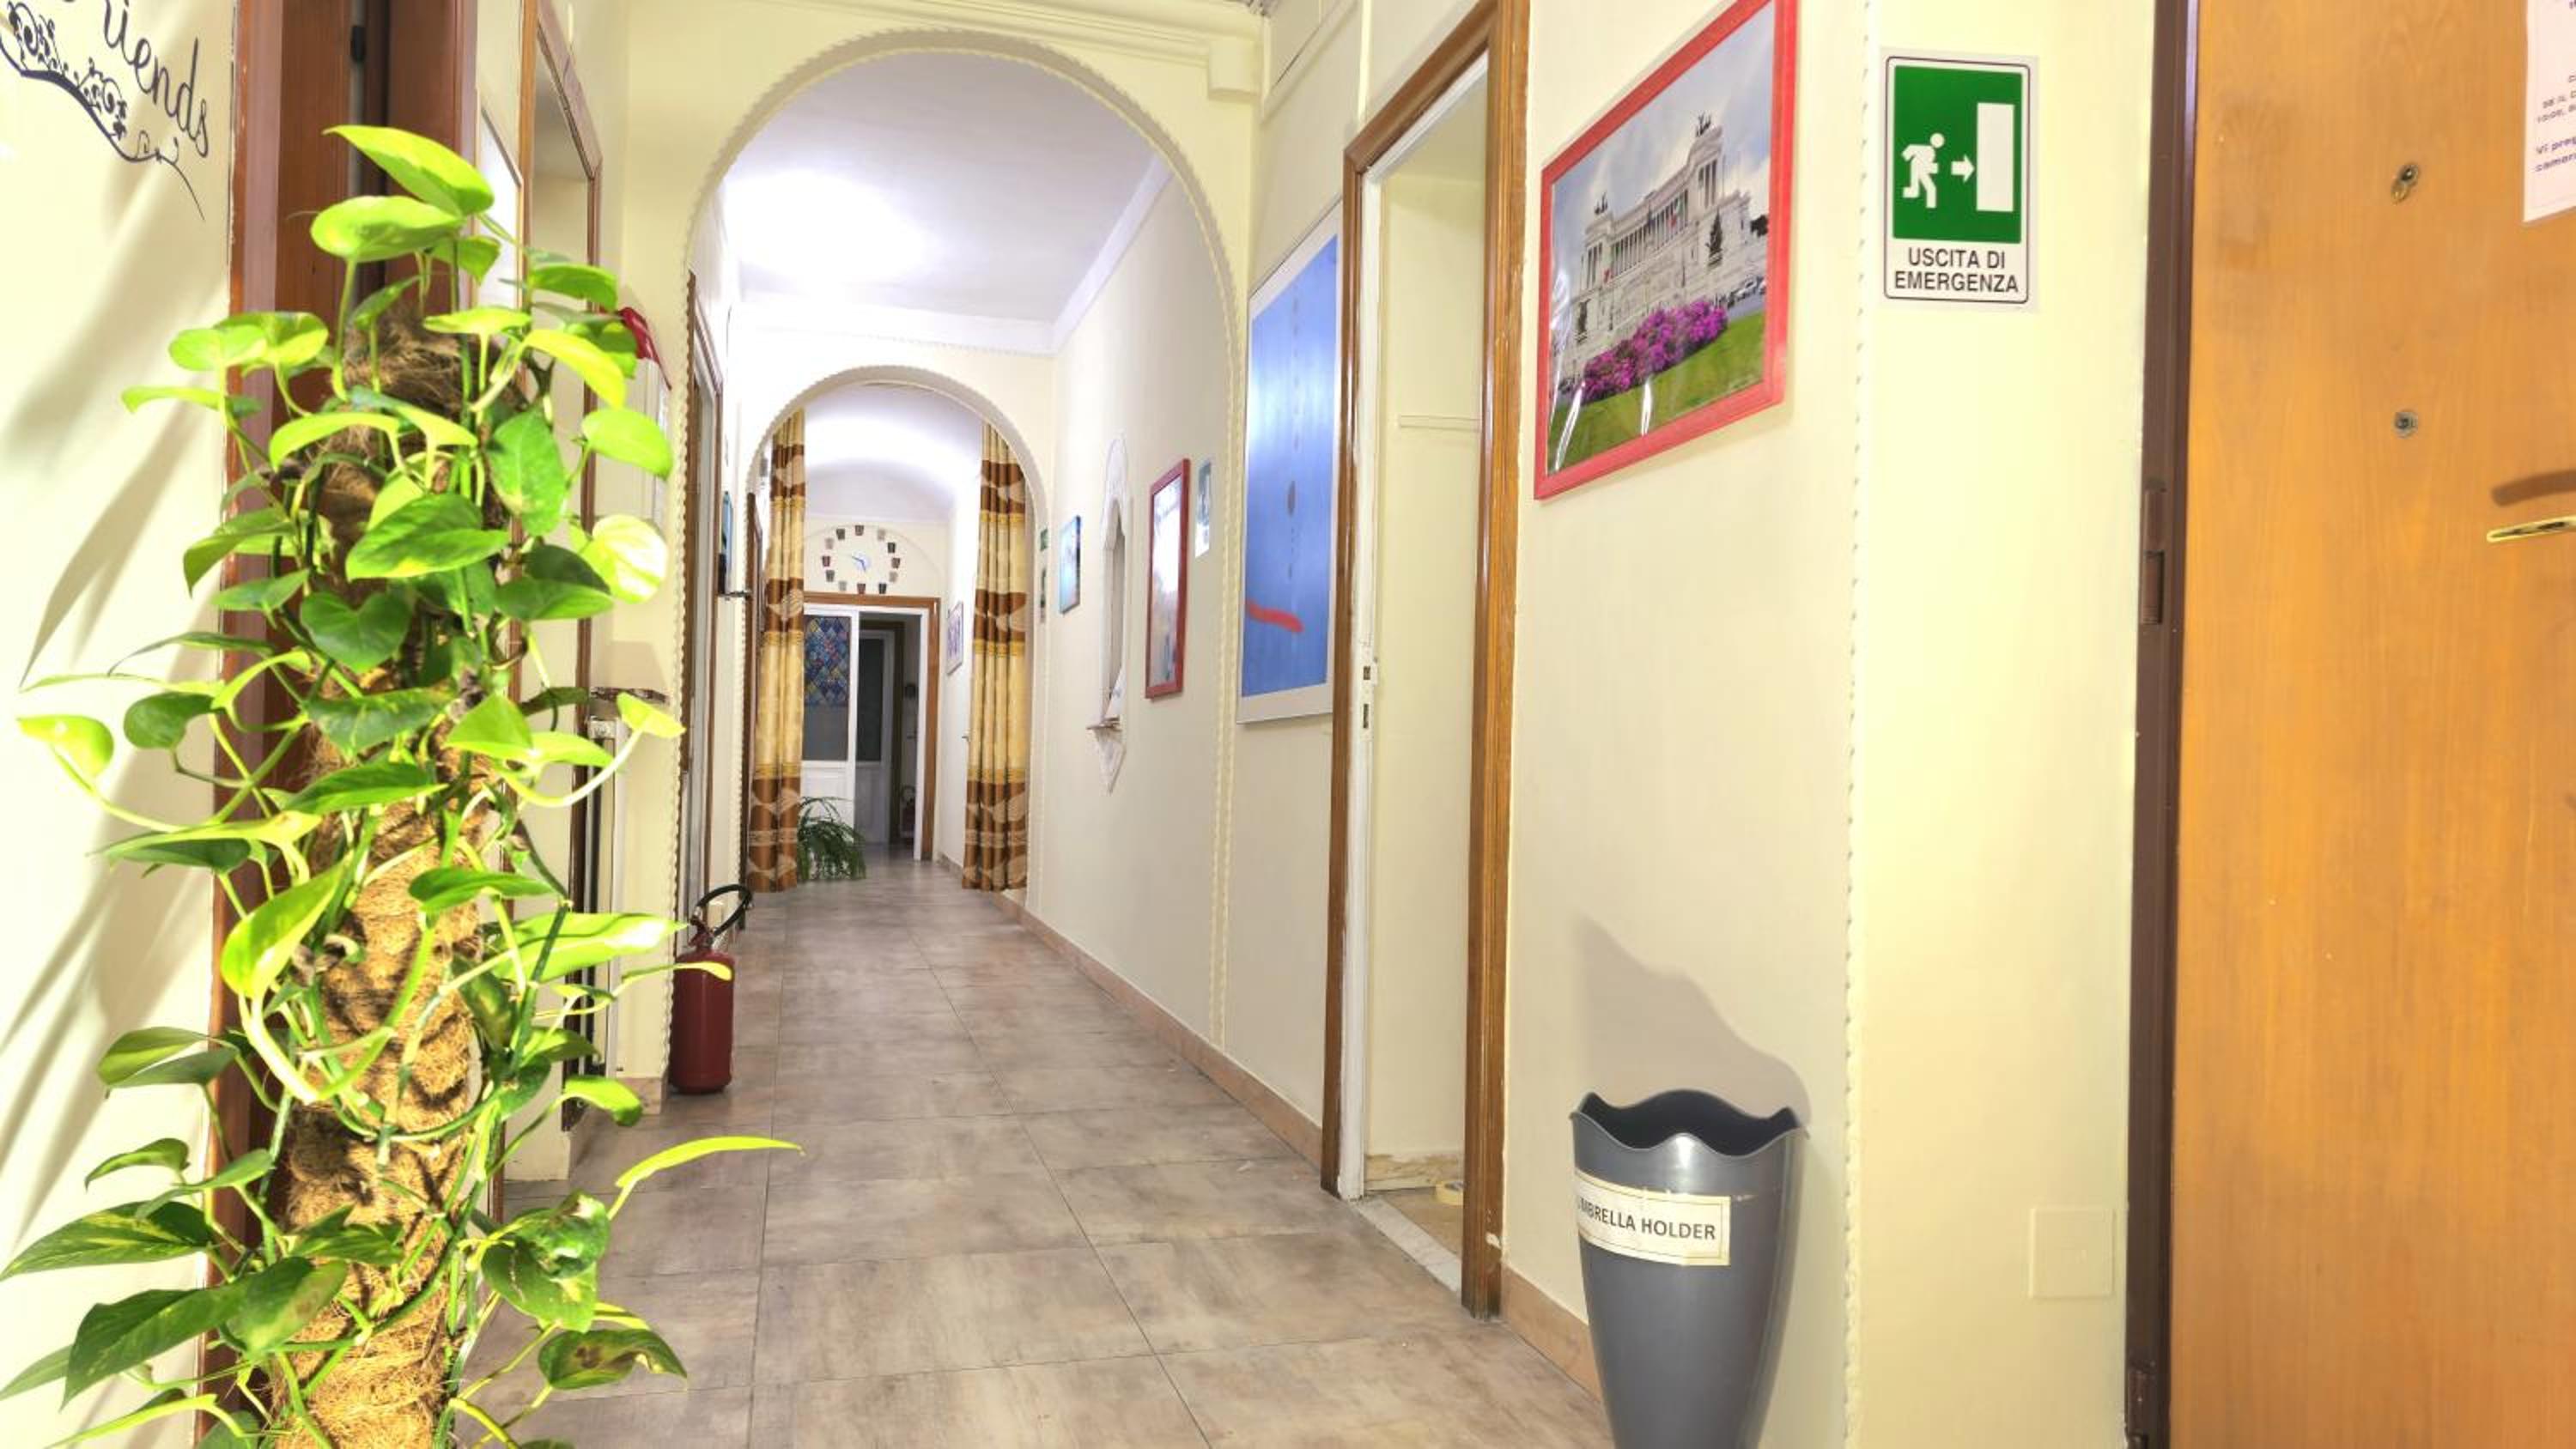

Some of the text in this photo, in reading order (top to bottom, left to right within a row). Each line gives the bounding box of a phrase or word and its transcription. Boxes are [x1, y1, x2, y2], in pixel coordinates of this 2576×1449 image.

[1908, 247, 2005, 269] USCITA DI
[1895, 270, 2019, 293] EMERGENZA
[1577, 1197, 1716, 1240] MBRELLA HOLDER
